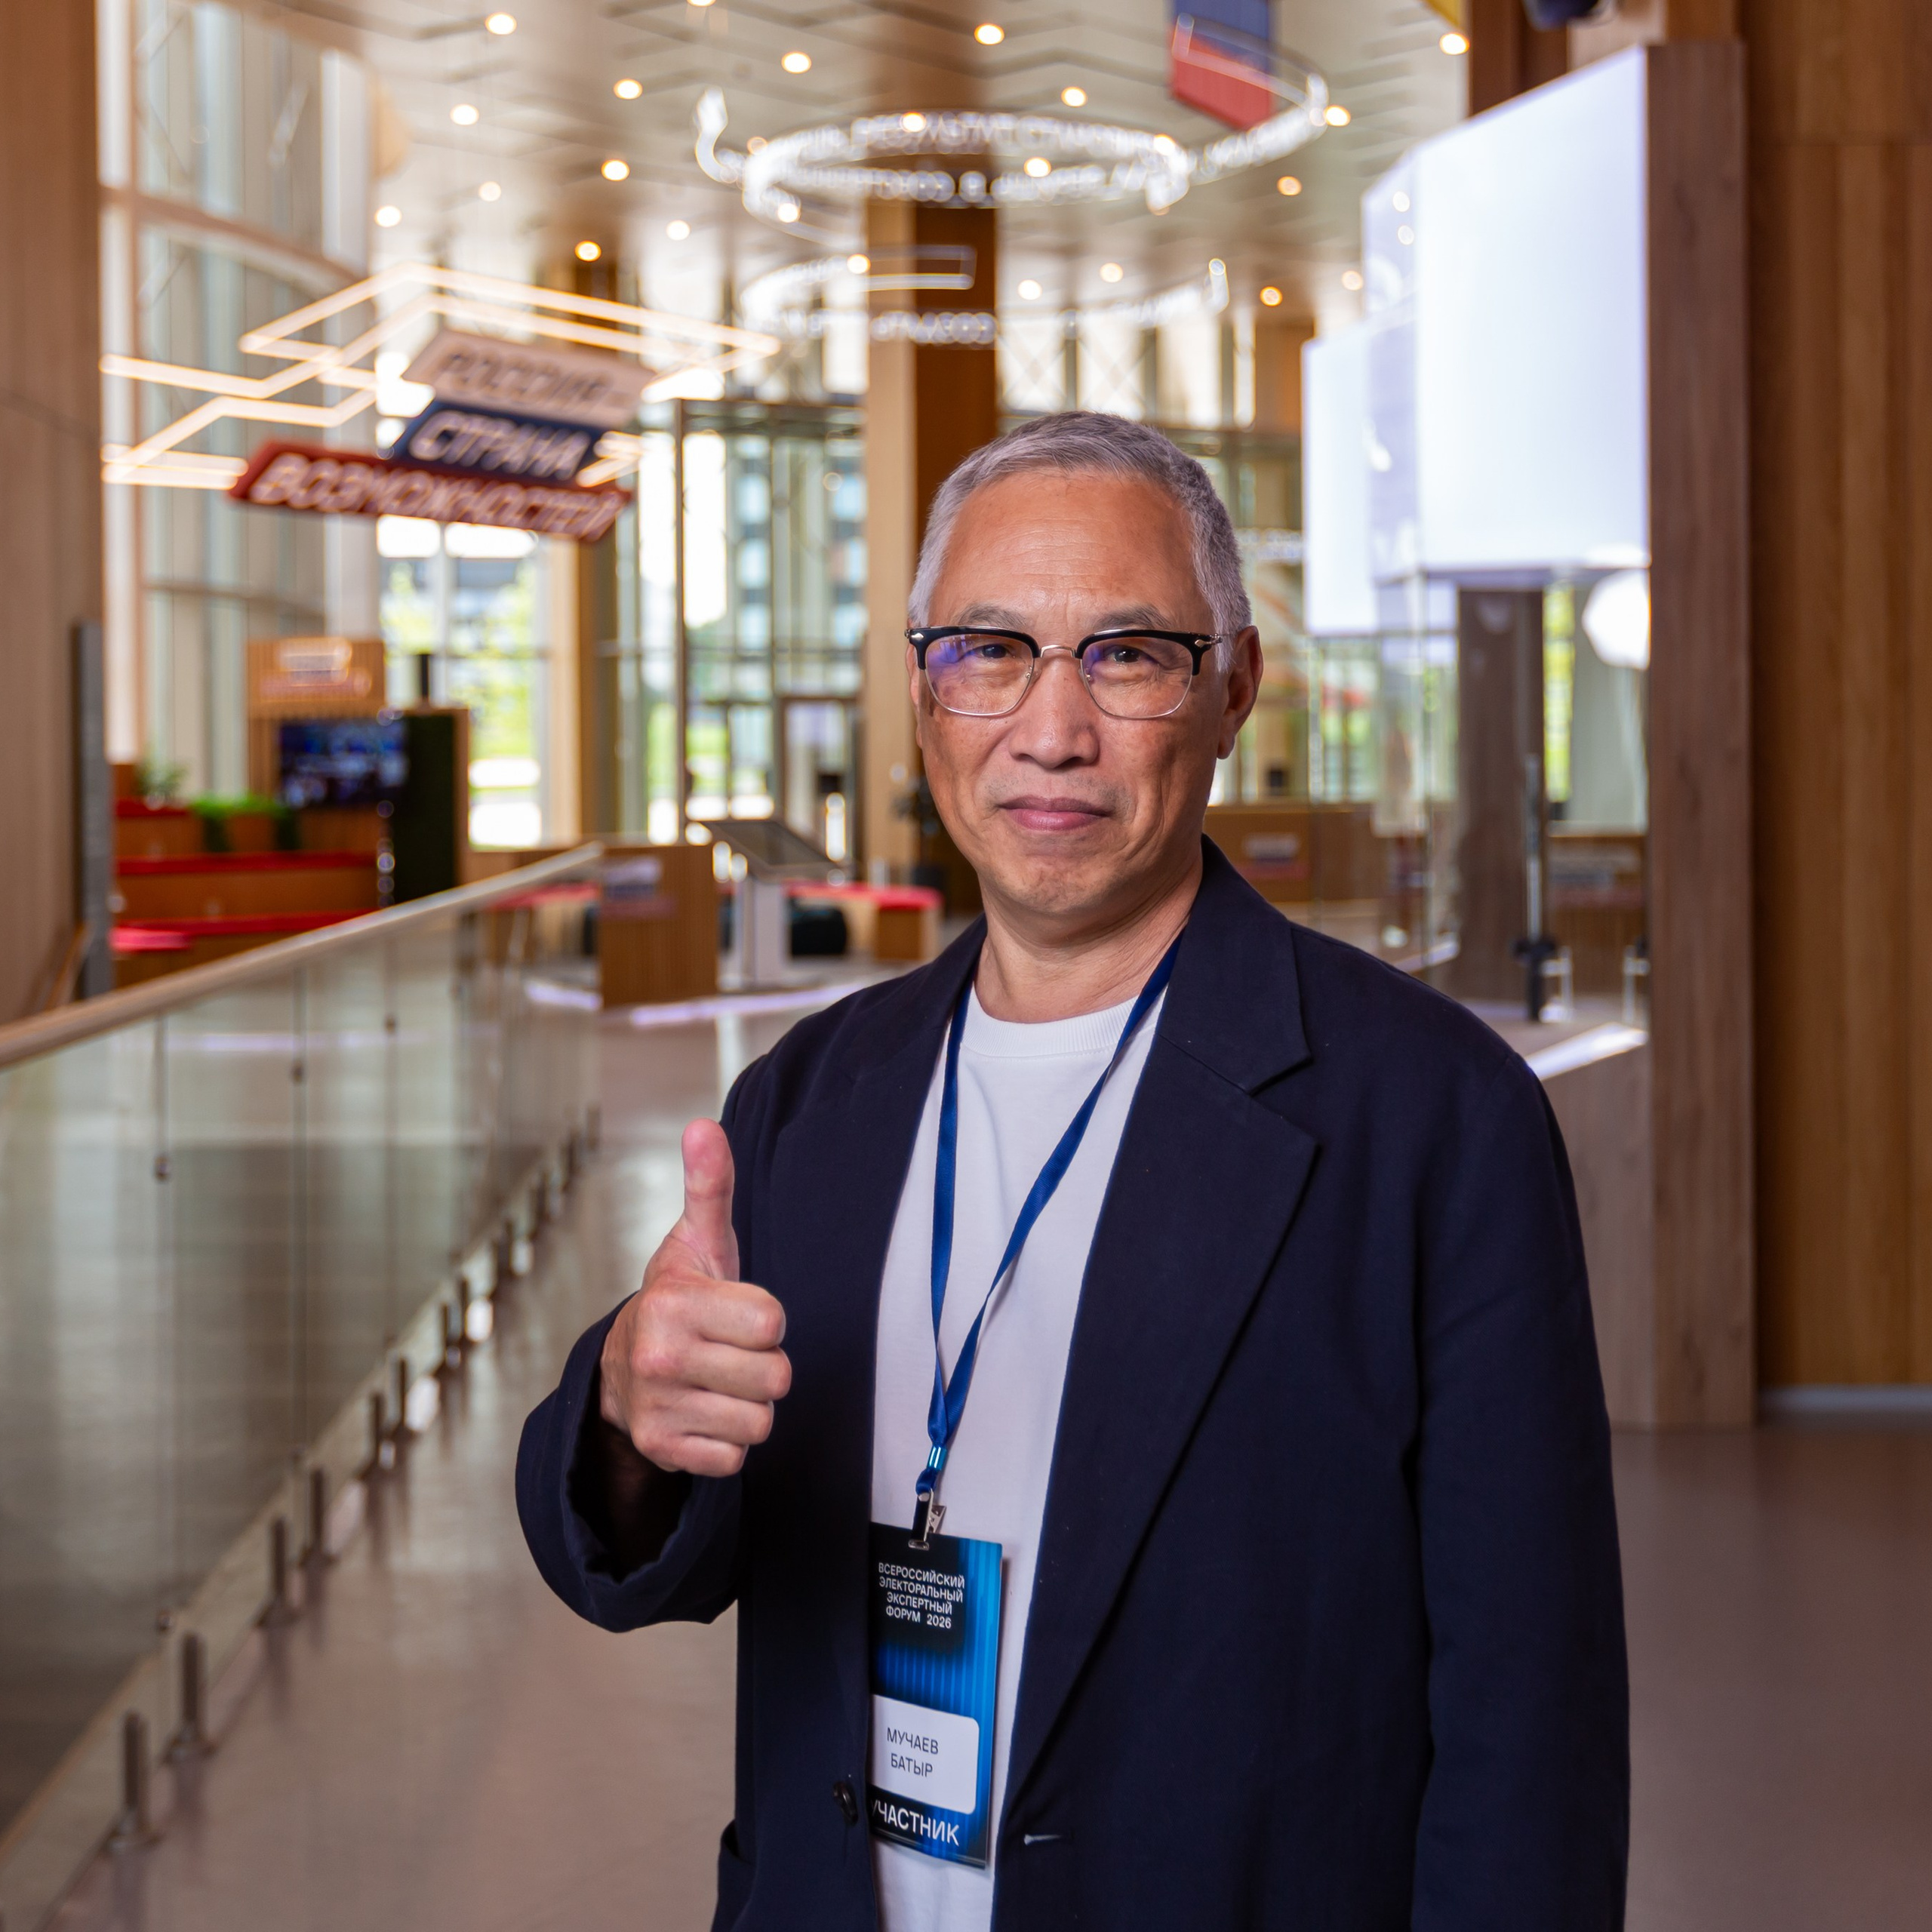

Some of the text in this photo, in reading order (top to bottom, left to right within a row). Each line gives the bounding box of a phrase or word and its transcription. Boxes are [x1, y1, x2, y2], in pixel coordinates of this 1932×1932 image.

[878, 1562, 965, 1589] ВСЕРОССИЙСКИЙ
[879, 1577, 964, 1603] ЭЛЕКТОРАЛЬНЫЙ
[887, 1592, 952, 1615] ЭКСПЕРТНЫЙ
[886, 1605, 952, 1629] ФОРУМ 2026
[887, 1727, 939, 1755] МУЧАЕВ
[891, 1752, 934, 1778] БАТЫР
